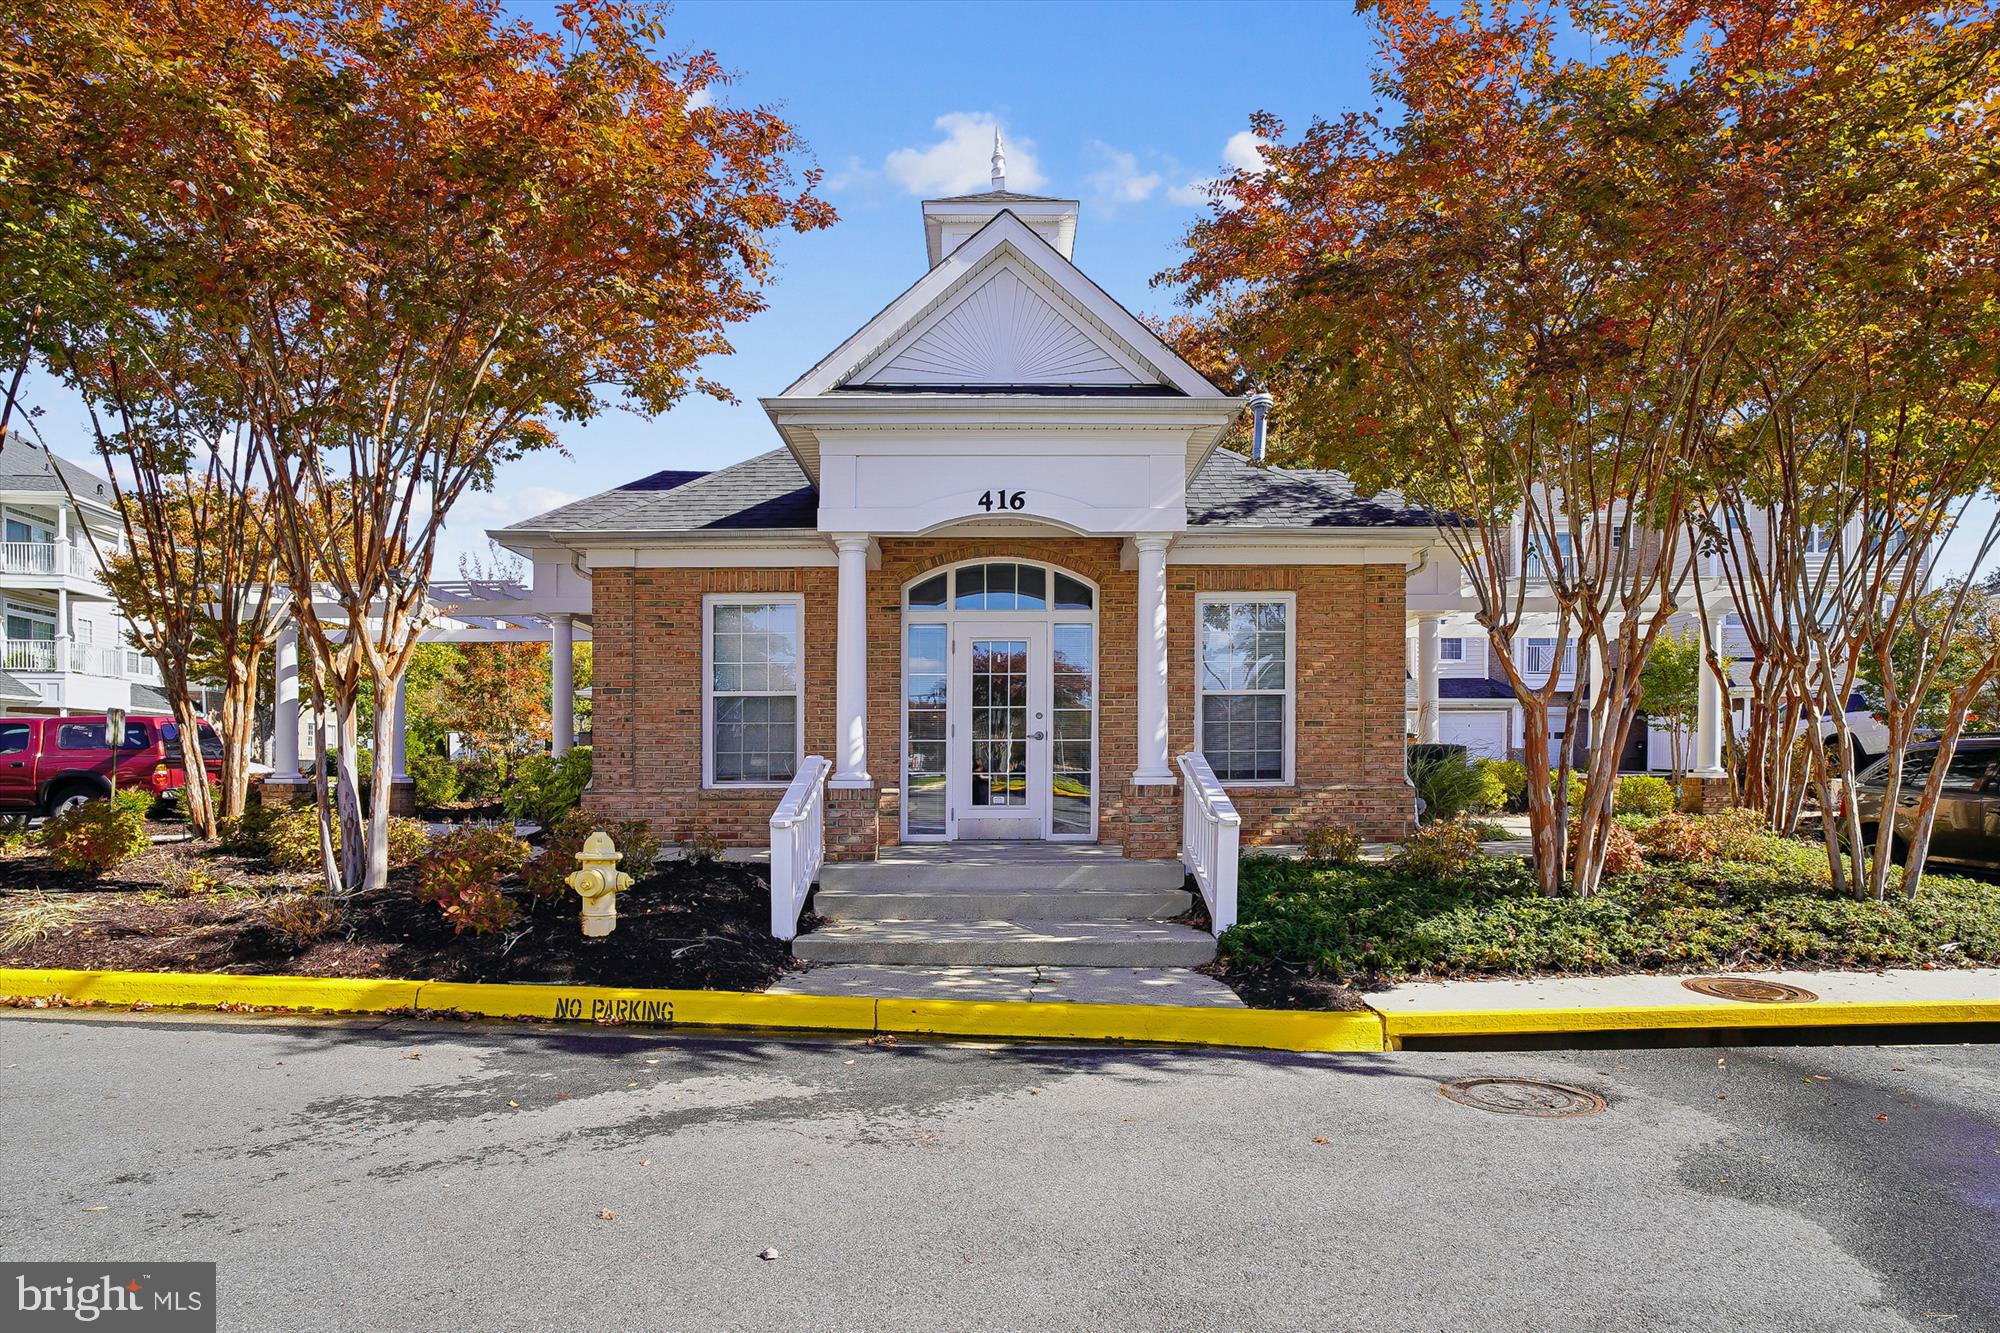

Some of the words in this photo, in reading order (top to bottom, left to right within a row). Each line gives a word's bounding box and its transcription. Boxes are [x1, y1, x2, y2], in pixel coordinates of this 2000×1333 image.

[978, 490, 1026, 512] 416
[555, 998, 582, 1019] NO
[591, 999, 674, 1022] PARKING
